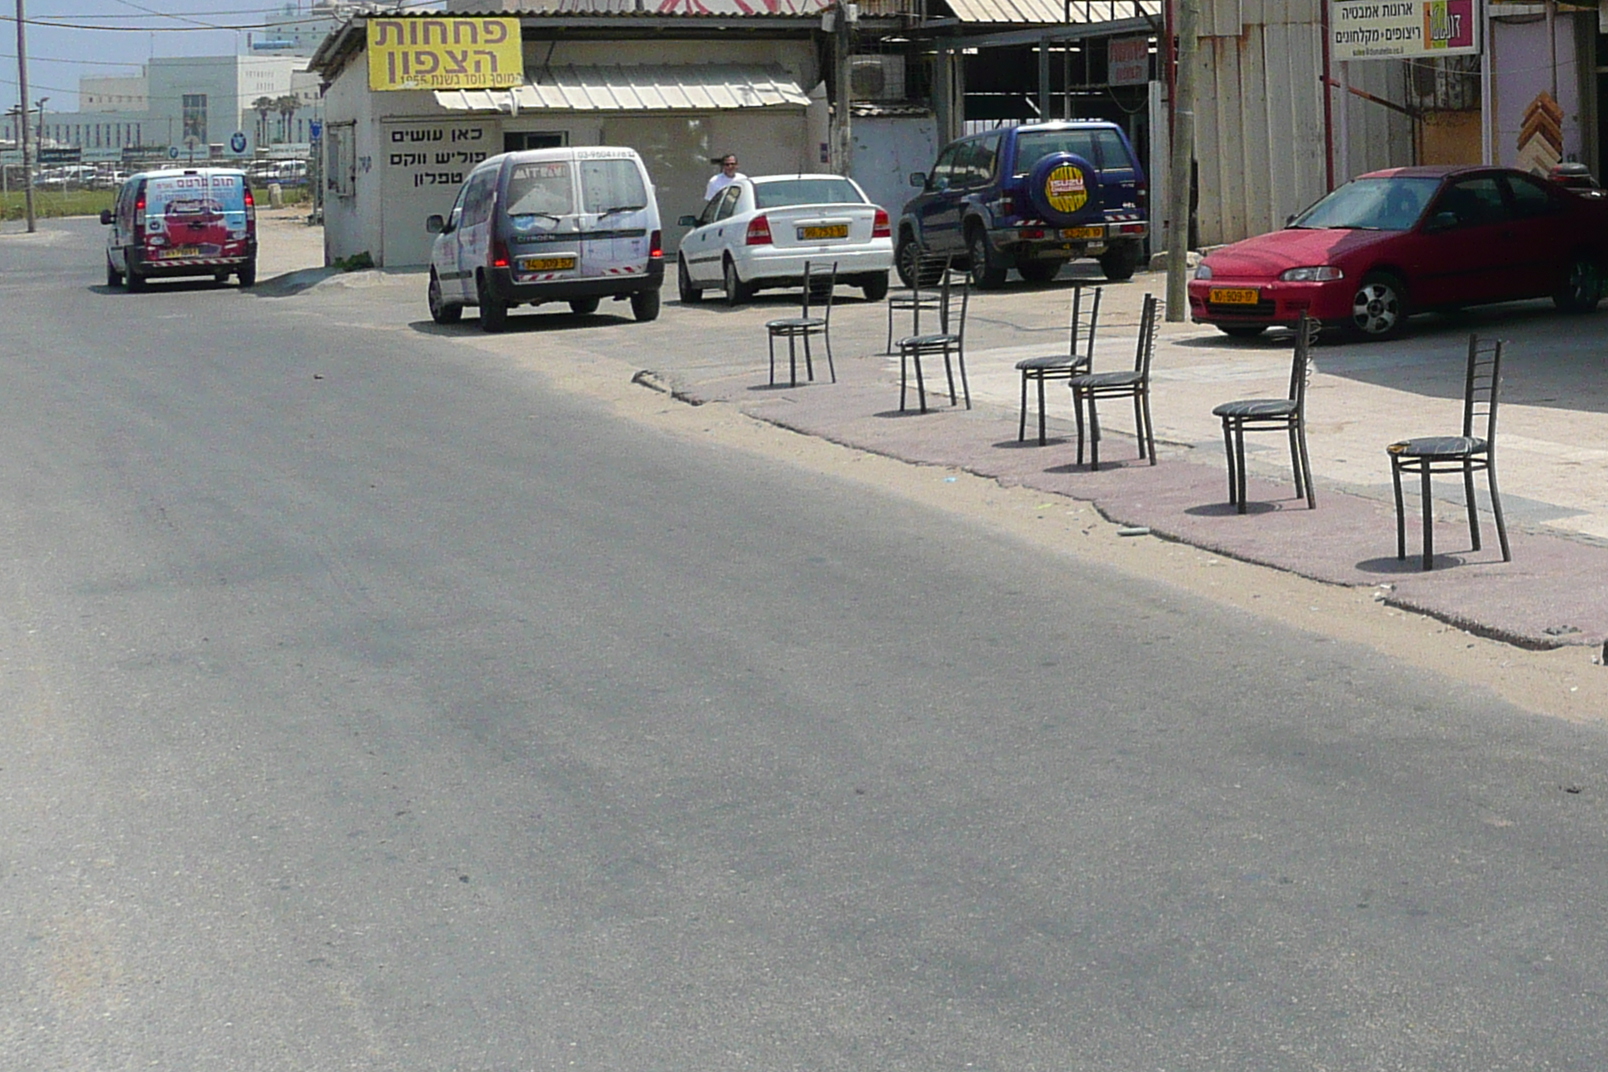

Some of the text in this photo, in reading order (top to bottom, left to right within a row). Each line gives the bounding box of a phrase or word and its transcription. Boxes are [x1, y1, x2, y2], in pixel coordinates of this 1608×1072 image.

[1342, 2, 1413, 20] ארונות אמבטיה
[375, 20, 508, 46] פחחות
[1336, 26, 1421, 45] ריצופים מקלחונים
[388, 49, 498, 84] הצפון
[431, 74, 461, 86] בשנת
[465, 73, 486, 85] נוסד
[391, 128, 483, 143] כאן עושים
[435, 151, 487, 164] פוליש
[414, 172, 463, 187] טפלון
